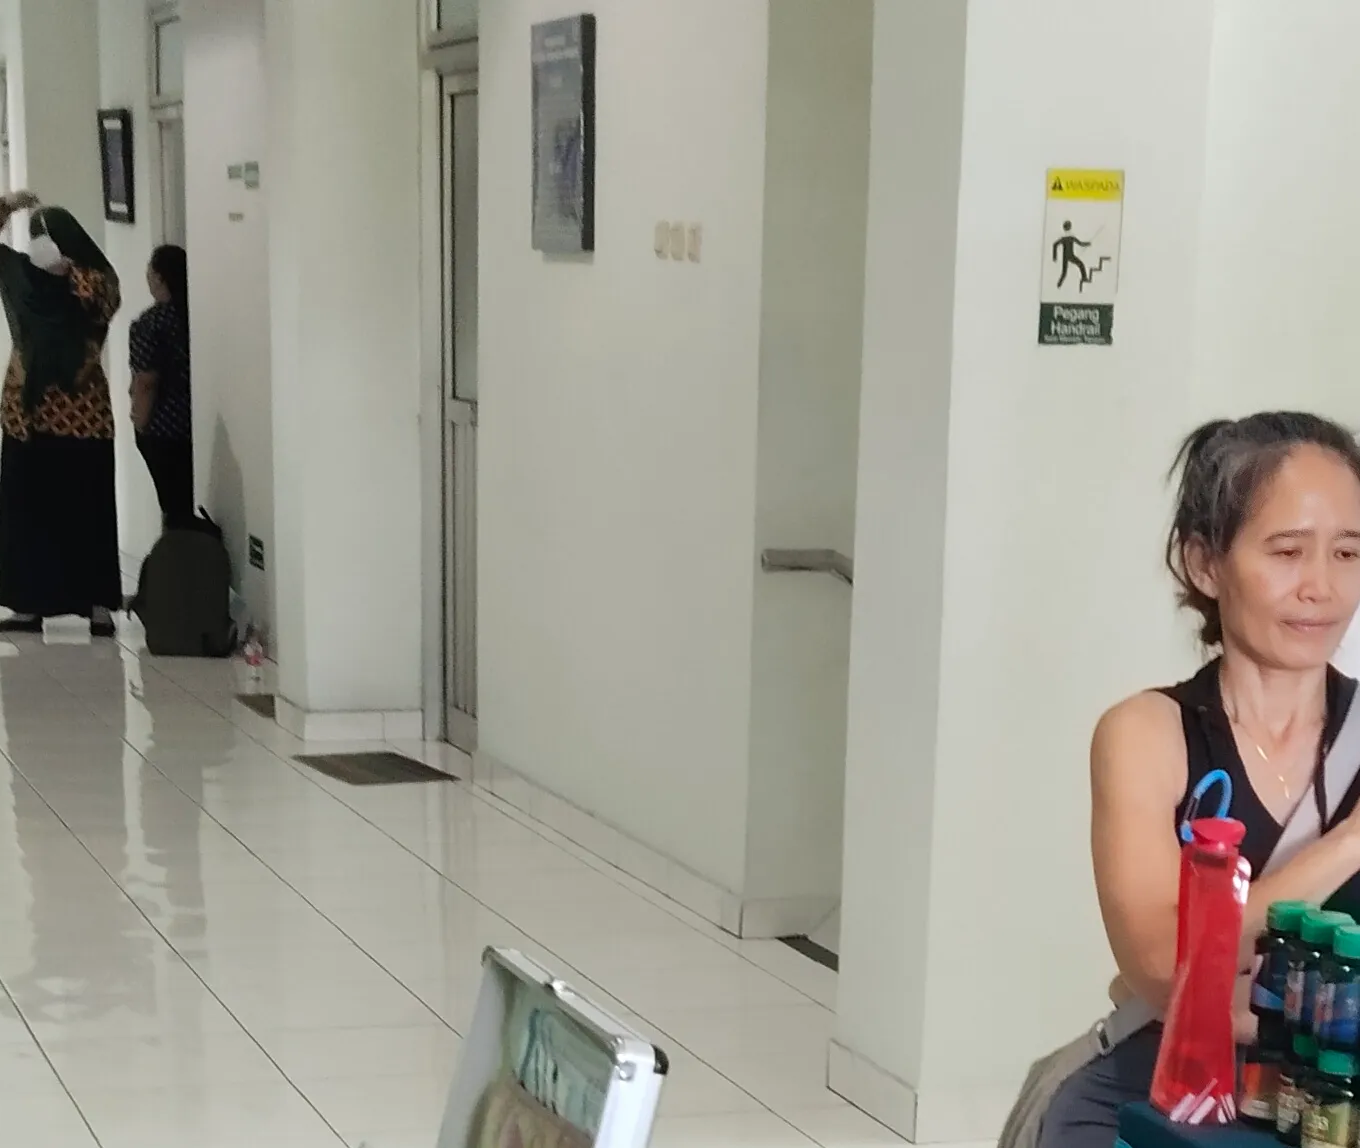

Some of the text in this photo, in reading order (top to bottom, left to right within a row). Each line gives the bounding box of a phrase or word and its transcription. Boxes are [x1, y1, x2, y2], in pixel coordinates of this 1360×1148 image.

[1066, 180, 1120, 192] WASPADA
[1053, 305, 1100, 325] Pegang
[1051, 320, 1101, 336] Handrail
